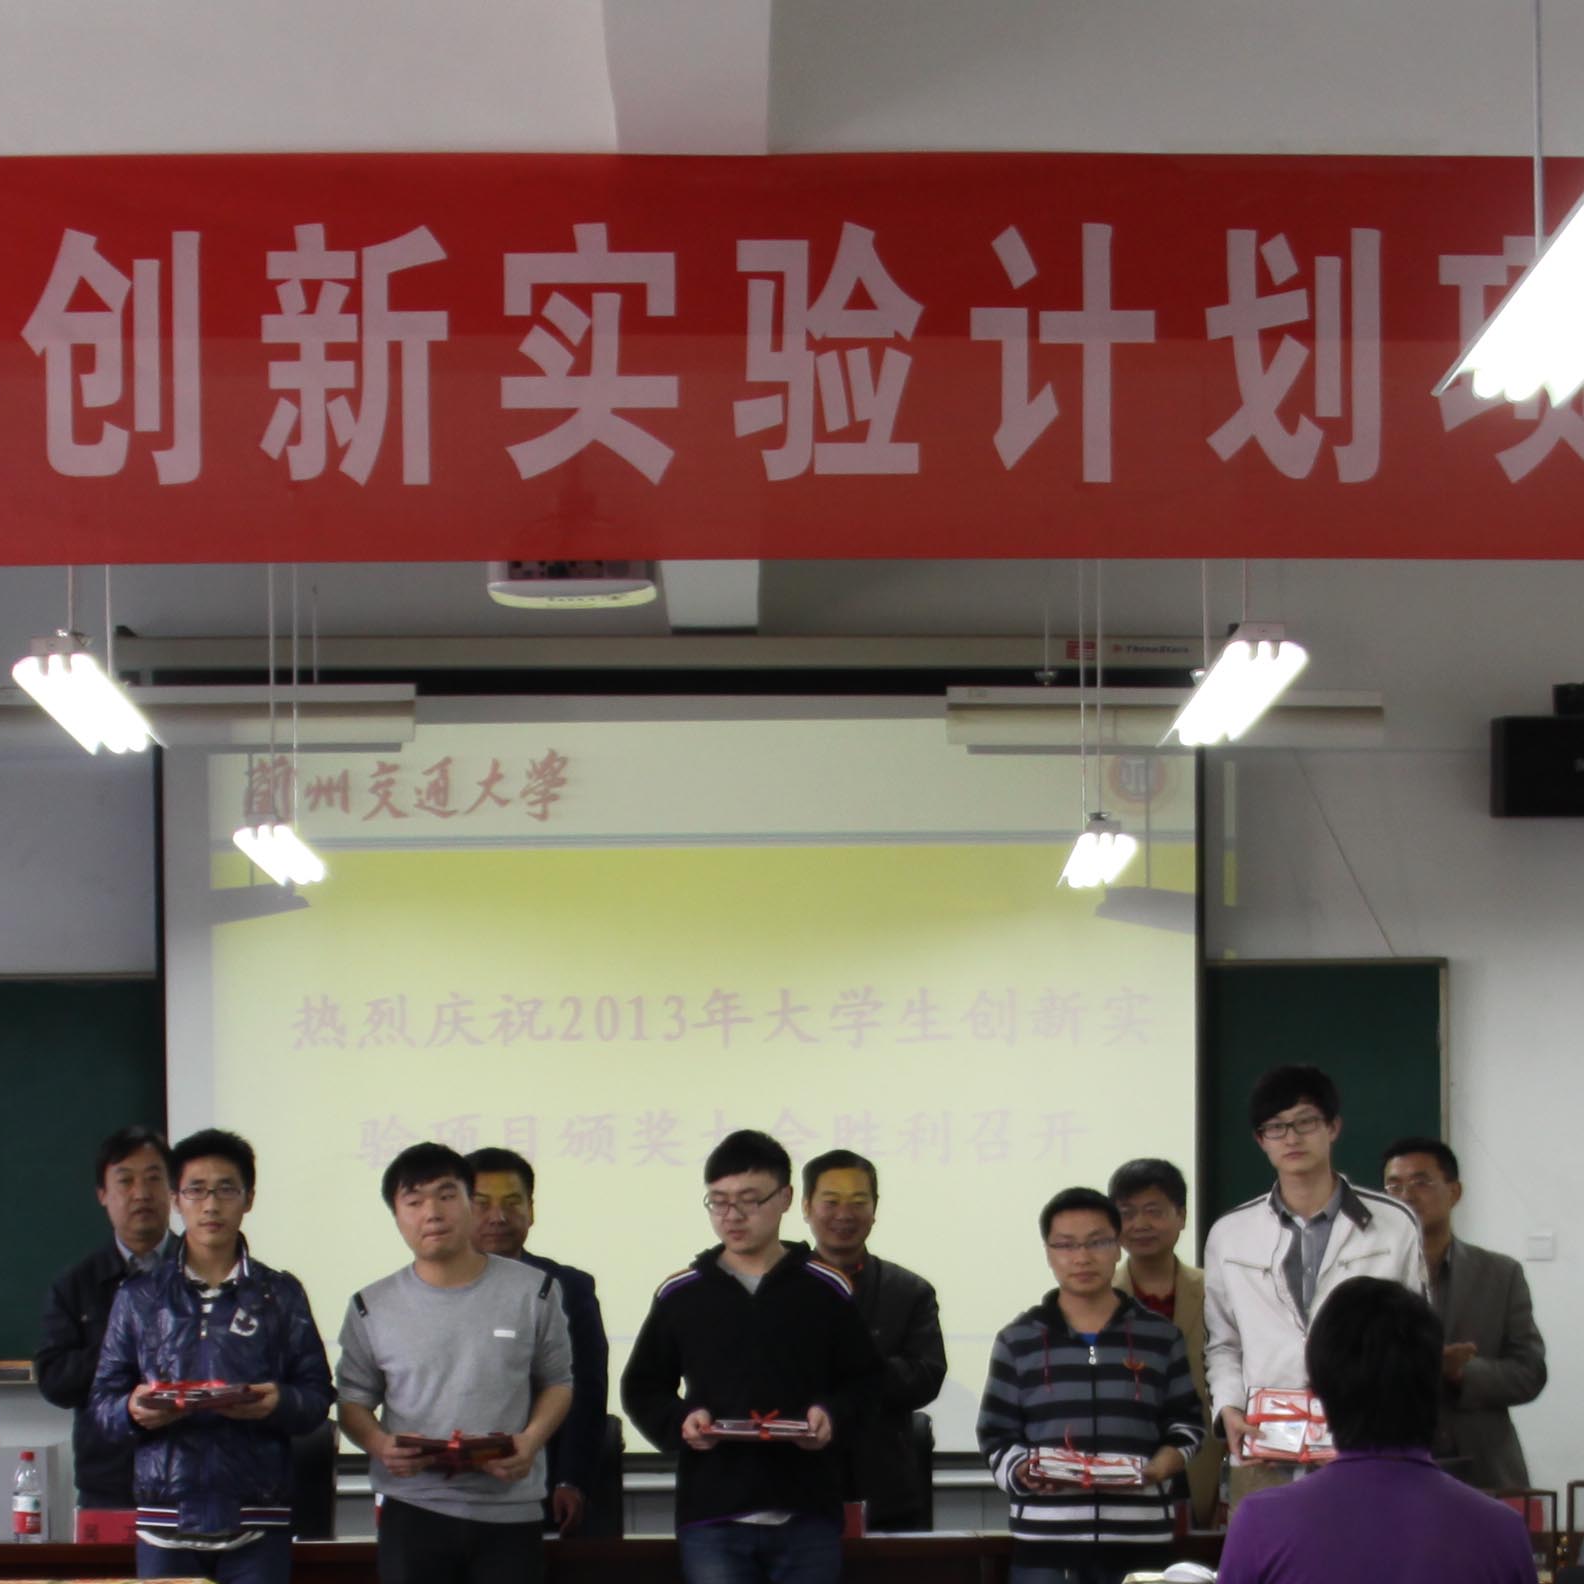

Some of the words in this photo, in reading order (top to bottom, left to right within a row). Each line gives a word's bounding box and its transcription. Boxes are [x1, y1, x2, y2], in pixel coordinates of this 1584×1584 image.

[291, 985, 1154, 1051] 热烈庆祝2013年大学生创新实
